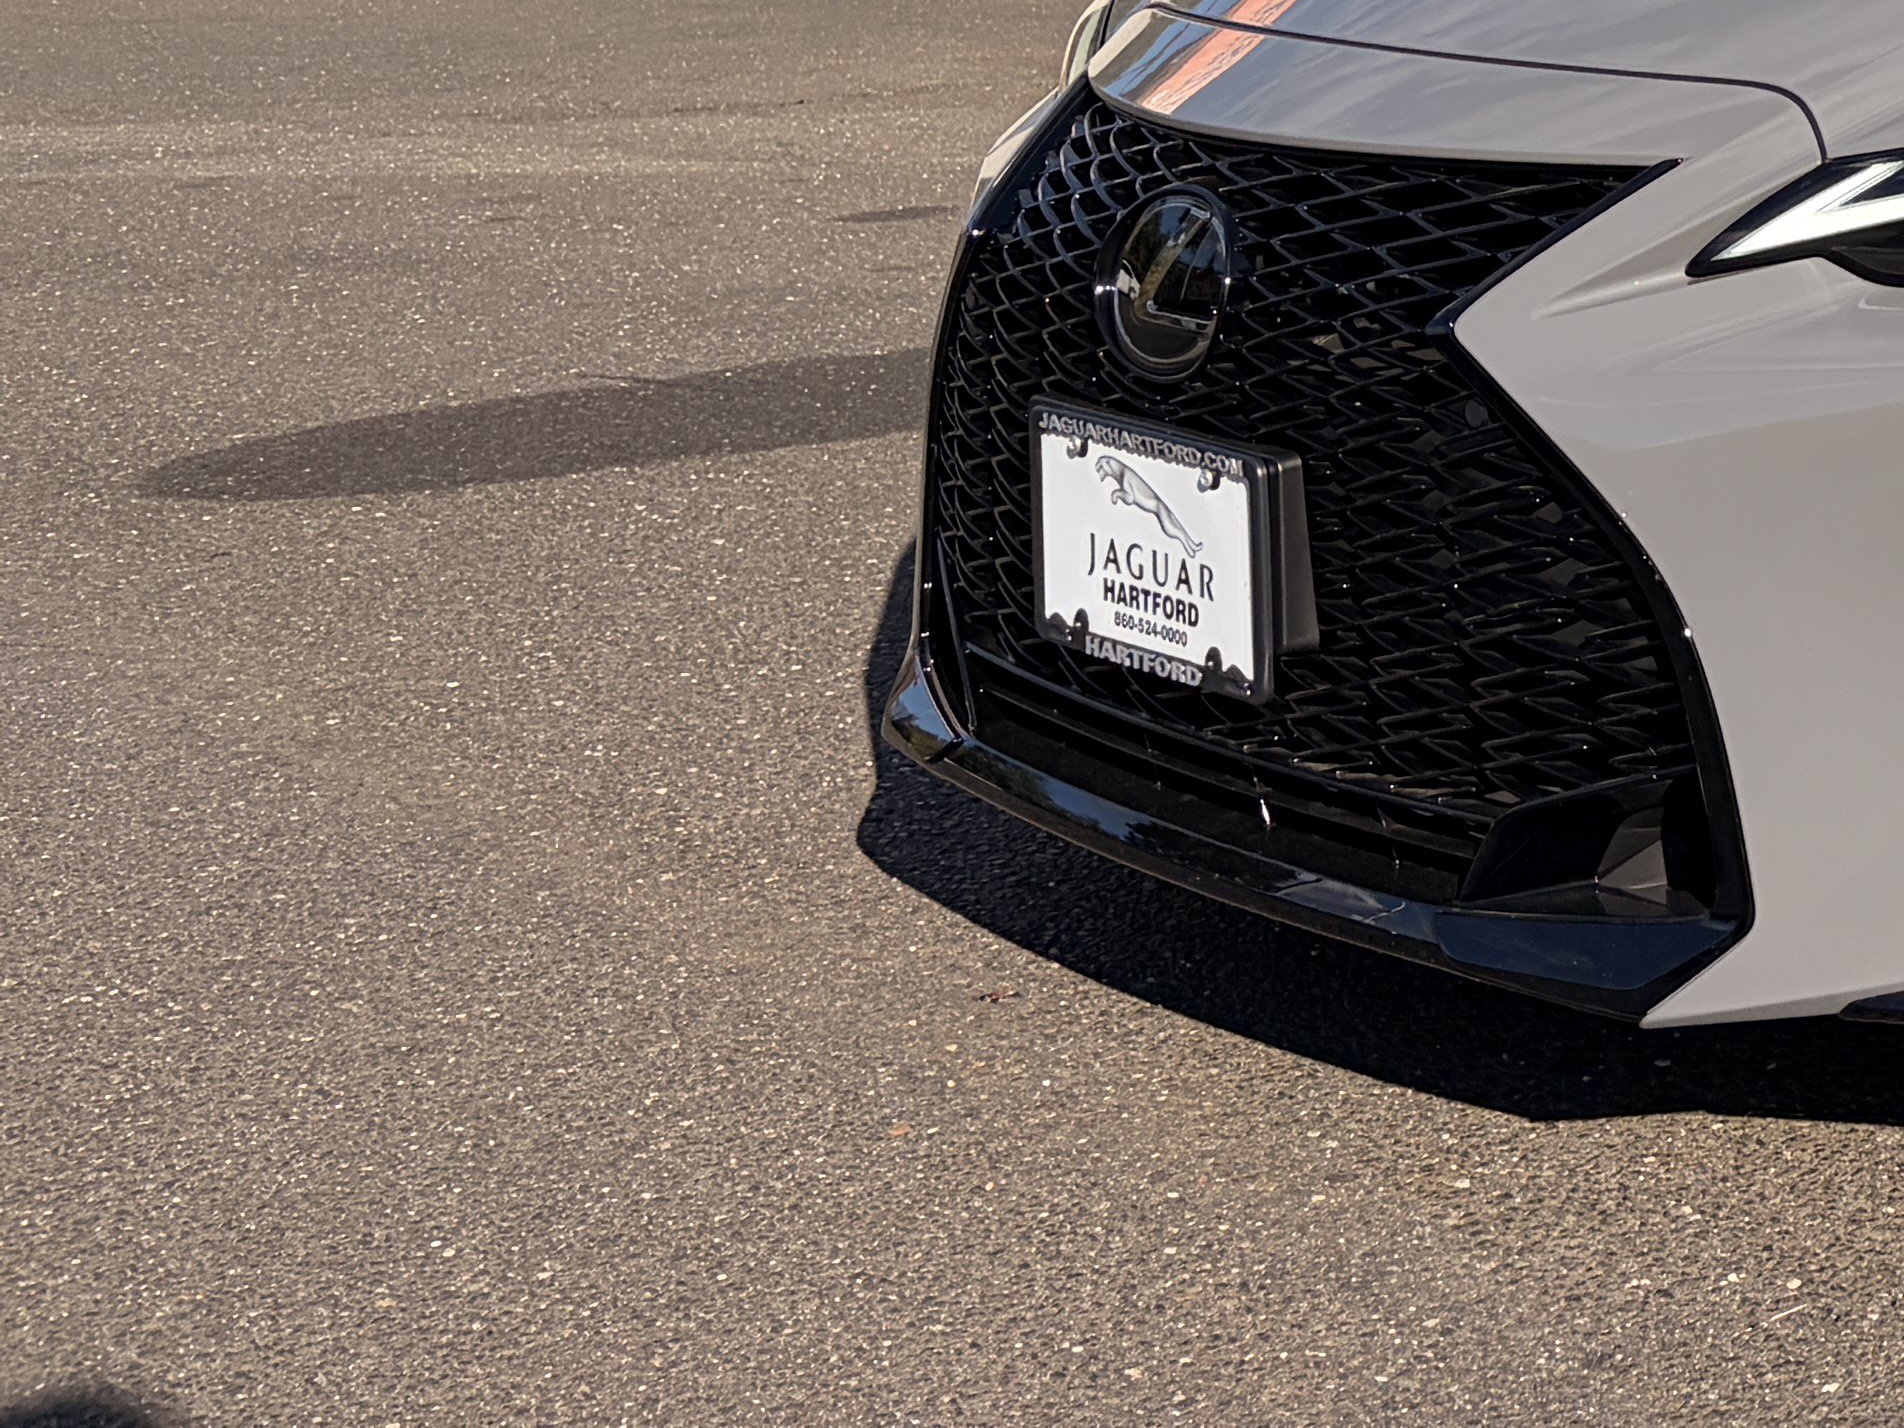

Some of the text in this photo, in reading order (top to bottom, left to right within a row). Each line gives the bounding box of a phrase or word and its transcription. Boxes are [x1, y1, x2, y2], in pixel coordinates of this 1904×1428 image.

[1039, 412, 1244, 476] JAGUARHARTFORD.COM
[1088, 532, 1214, 602] JAGUAR
[1103, 577, 1199, 628] HARTFORD
[1114, 610, 1188, 647] 860-524-0000
[1085, 635, 1202, 687] HARTFORD
